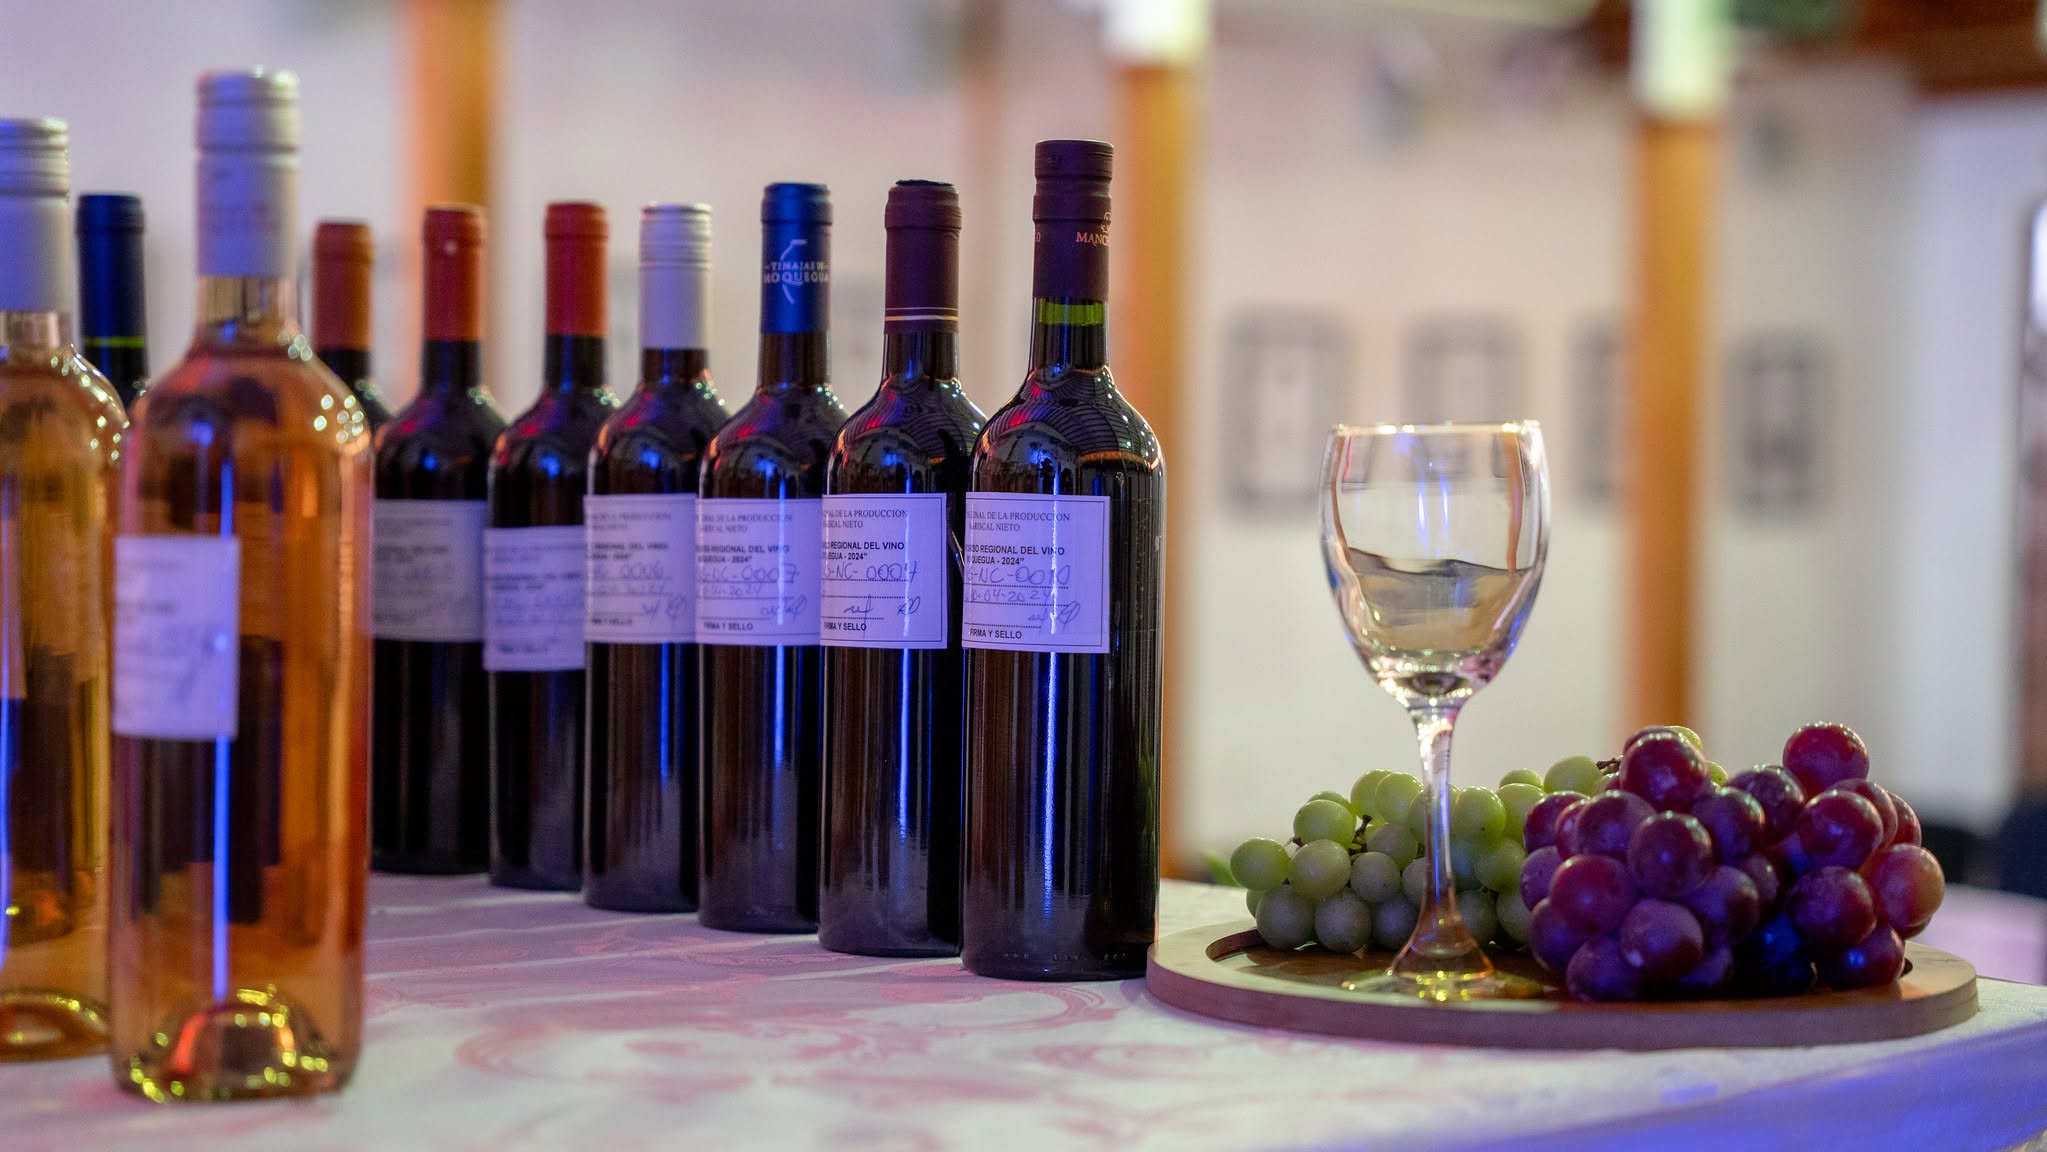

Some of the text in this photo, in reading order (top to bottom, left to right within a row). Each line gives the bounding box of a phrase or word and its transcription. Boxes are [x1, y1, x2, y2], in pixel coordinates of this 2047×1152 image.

[844, 510, 852, 518] LA
[854, 509, 908, 518] PRODUCCION
[842, 520, 863, 528] NIETO
[996, 523, 1020, 532] NIETO
[830, 541, 862, 550] REGIONAL
[863, 541, 880, 550] DEL
[882, 541, 905, 550] VINO
[980, 544, 1018, 554] REGIONAL
[1020, 546, 1039, 555] DEL
[1041, 547, 1065, 556] VINO
[843, 622, 867, 631] SELLO
[988, 630, 993, 638] Y
[994, 630, 1022, 639] SELLO
